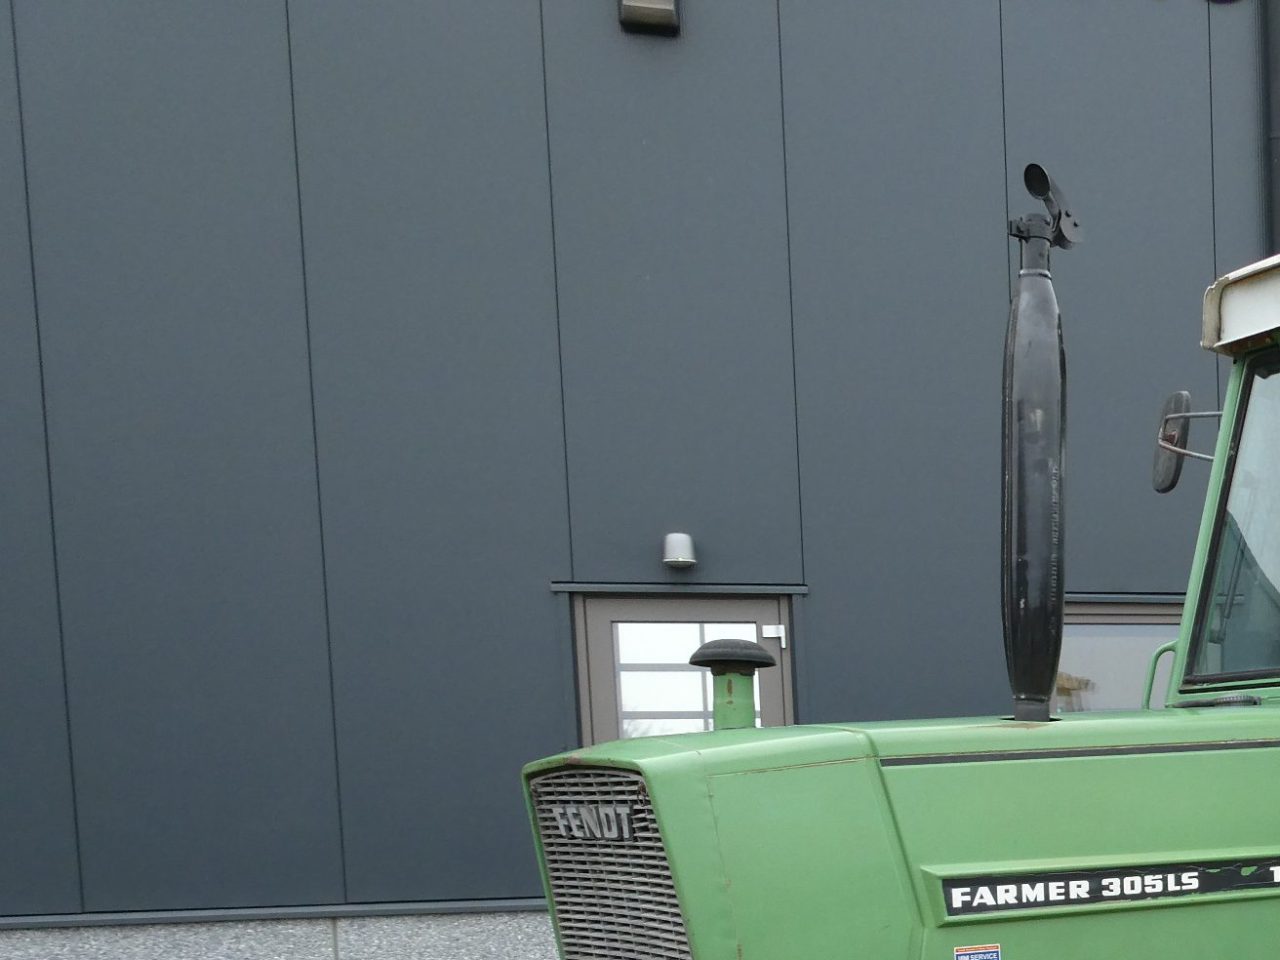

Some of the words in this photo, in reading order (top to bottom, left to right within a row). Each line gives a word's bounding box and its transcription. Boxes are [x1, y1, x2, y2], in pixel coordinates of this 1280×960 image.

[552, 805, 632, 839] FENDT
[951, 880, 1090, 908] FARMER
[970, 952, 998, 960] SERVICE
